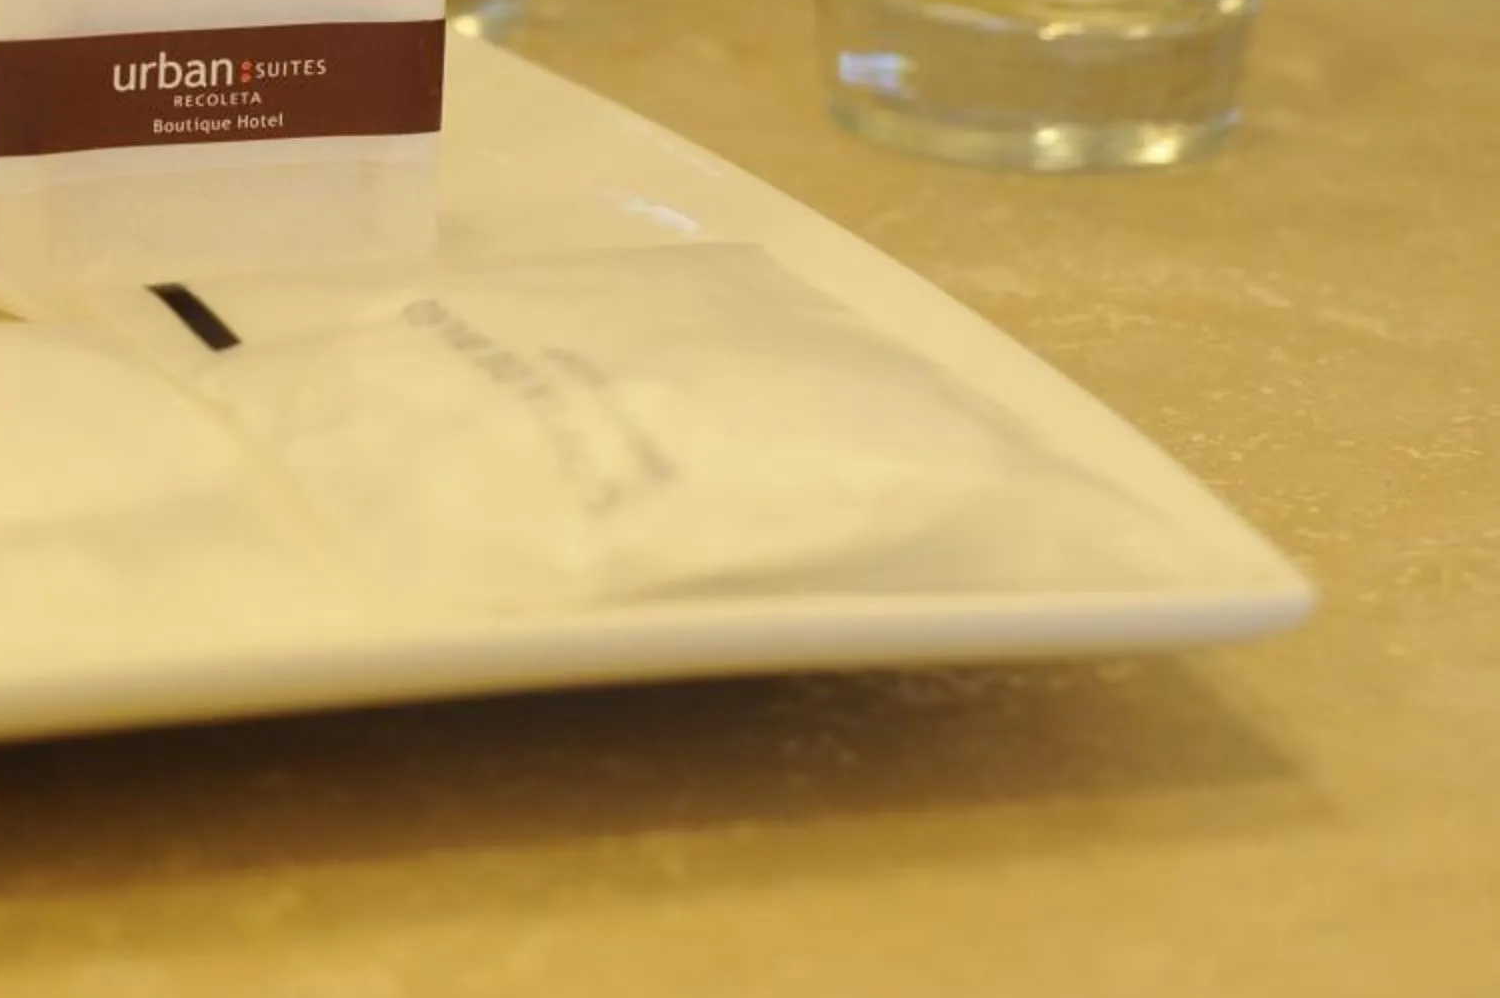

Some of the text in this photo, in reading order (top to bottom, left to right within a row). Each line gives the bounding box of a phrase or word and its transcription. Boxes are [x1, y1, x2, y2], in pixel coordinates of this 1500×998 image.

[256, 58, 328, 80] SUITES
[173, 91, 262, 108] RECOLETA
[152, 112, 284, 135] Boutique Hotel
